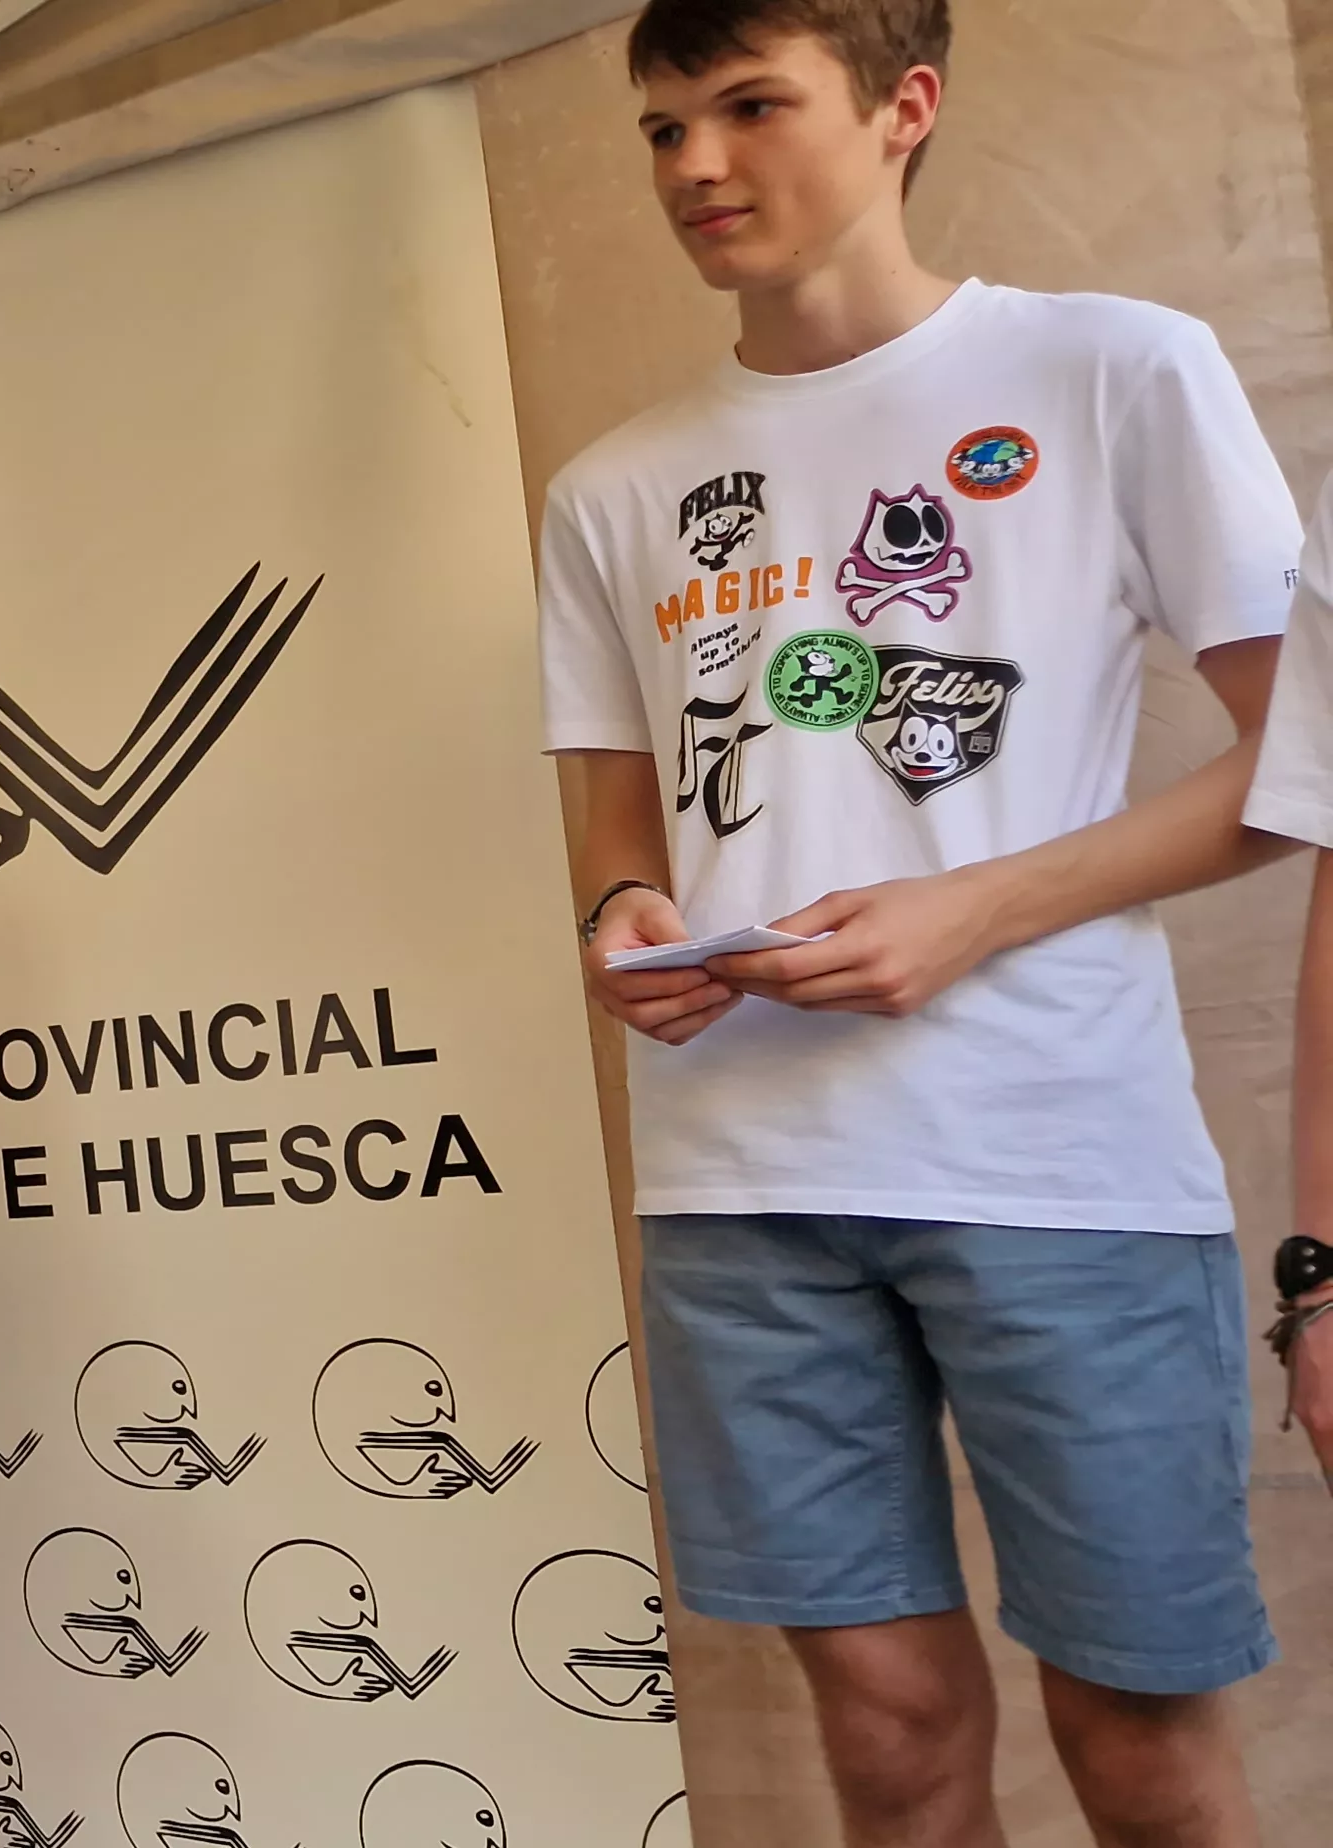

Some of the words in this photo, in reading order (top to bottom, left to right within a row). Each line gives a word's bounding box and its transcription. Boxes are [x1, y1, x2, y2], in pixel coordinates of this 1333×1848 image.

[678, 471, 766, 540] FELIX
[654, 556, 814, 644] MAGIC!
[698, 626, 762, 677] something
[700, 645, 719, 661] up
[725, 636, 741, 655] to
[774, 637, 819, 676] SOMETHING
[822, 637, 860, 656] ALWAYS
[856, 653, 867, 666] UP
[861, 667, 871, 681] TO
[871, 660, 1005, 717] Felix
[80, 1114, 503, 1216] HUESCA
